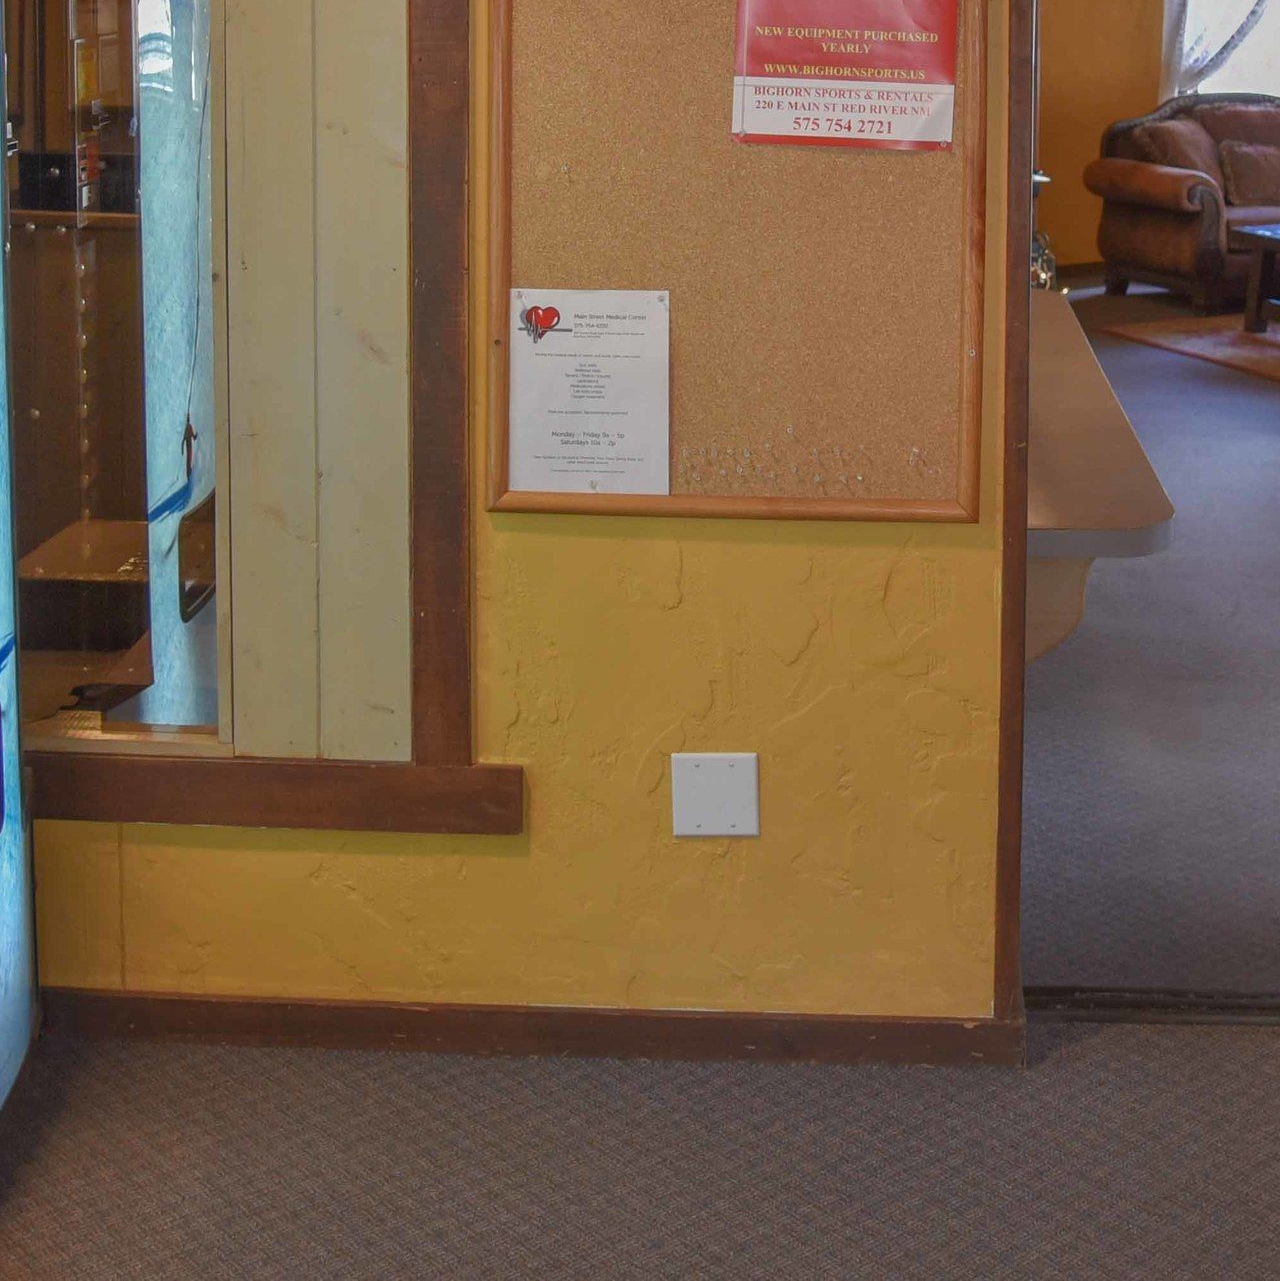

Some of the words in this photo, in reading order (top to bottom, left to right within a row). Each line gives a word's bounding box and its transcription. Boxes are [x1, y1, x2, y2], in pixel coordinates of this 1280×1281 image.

[755, 26, 784, 37] NEW
[787, 27, 860, 40] EQUIPMENT
[864, 31, 939, 43] PURCHASED
[821, 42, 872, 54] YEARLY
[763, 63, 926, 79] WWW.BIGHORNSPORTS.US
[754, 86, 811, 98] BIGHORN
[814, 87, 861, 100] SPORTS
[864, 90, 874, 100] &
[877, 91, 933, 102] RENTALS
[755, 99, 773, 110] 220
[777, 101, 784, 110] E
[788, 101, 819, 112] MAIN
[823, 102, 838, 113] ST
[841, 103, 866, 114] RED
[869, 104, 908, 116] RIVER
[911, 105, 930, 116] NM
[793, 117, 820, 131] 575
[826, 118, 852, 133] 754
[856, 119, 893, 134] 2721
[551, 431, 575, 439] Monday
[583, 431, 600, 439] Friday
[560, 439, 589, 447] Saturdays
